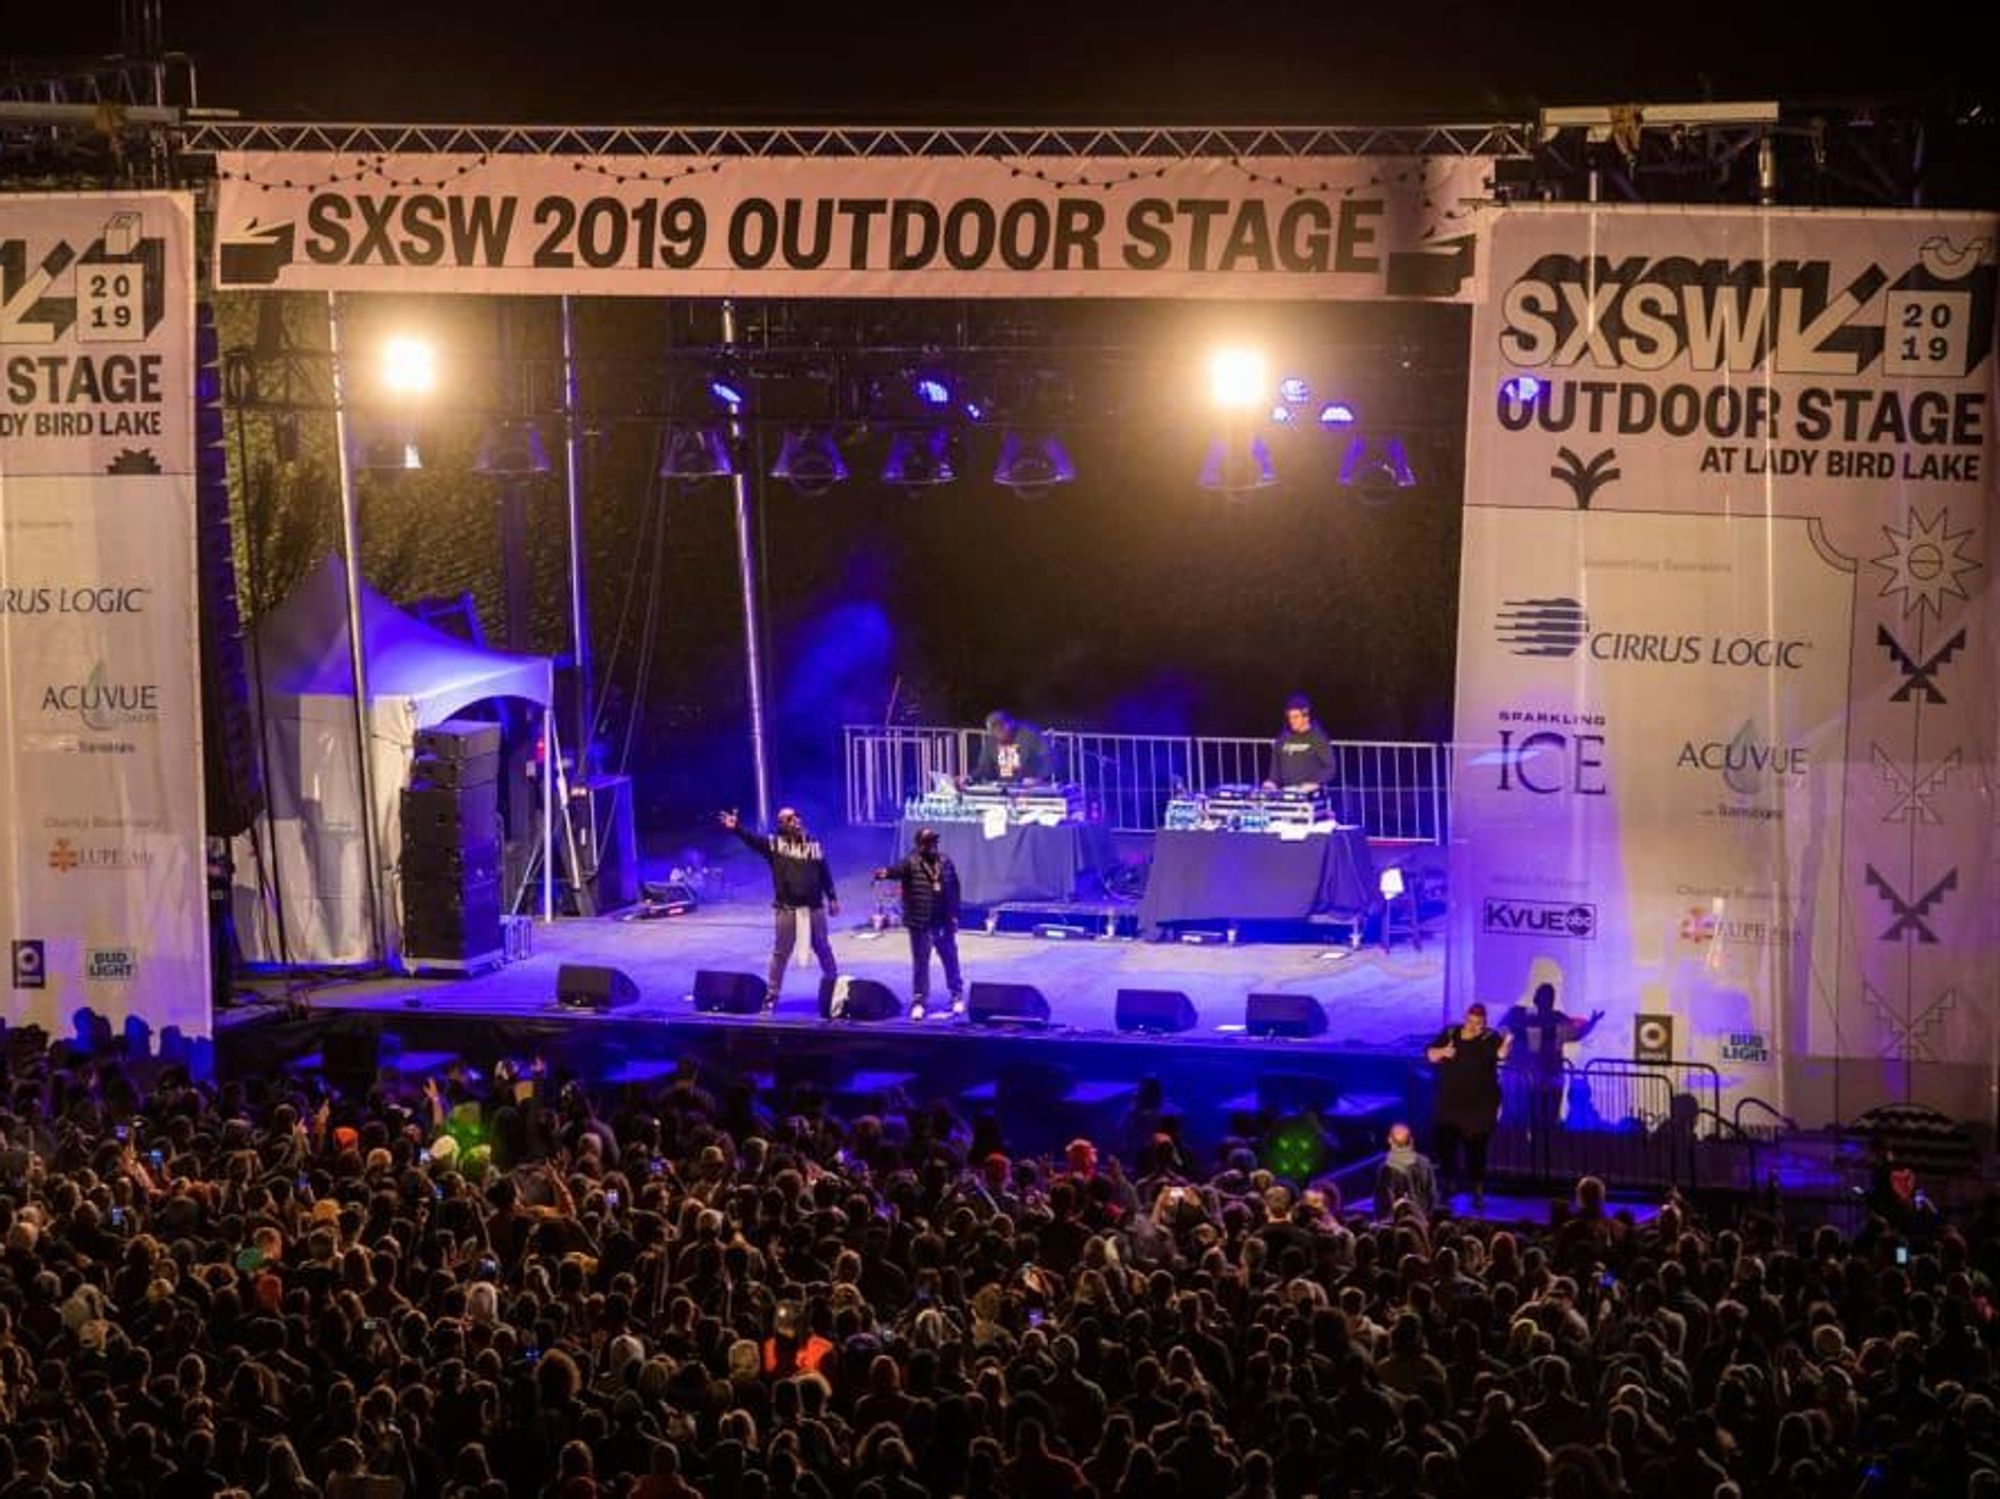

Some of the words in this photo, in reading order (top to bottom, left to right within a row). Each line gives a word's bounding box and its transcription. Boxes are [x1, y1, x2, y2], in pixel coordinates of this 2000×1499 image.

[304, 193, 517, 268] SXSW
[533, 197, 707, 269] 2019
[728, 197, 1105, 272] OUTDOOR
[1121, 197, 1384, 274] STAGE
[89, 274, 131, 299] 20
[90, 306, 132, 328] 19
[1499, 277, 1769, 373] SXSW
[1903, 302, 1952, 330] 20
[1901, 335, 1949, 363] 19
[6, 354, 163, 404] STAGE
[35, 412, 94, 437] BIRD
[99, 410, 162, 436] LAKE
[1497, 375, 1782, 440] OUTDOOR
[1795, 388, 1986, 446] STAGE
[1699, 446, 1738, 474] AT
[1744, 447, 1820, 477] LADY
[1826, 450, 1895, 479] BIRD
[1902, 452, 1981, 482] LAKE
[0, 588, 51, 614] RUS
[59, 588, 144, 613] LOGIC
[1590, 632, 1702, 665] CIRRUS
[1711, 637, 1805, 669] LOGIC
[42, 684, 159, 711] ACUVUE
[1499, 711, 1606, 727] SPARKLING
[1497, 730, 1606, 796] ICE
[1677, 741, 1808, 776] ACUVUE
[1487, 903, 1565, 931] KVUE
[1722, 1045, 1768, 1062] LIGHT
